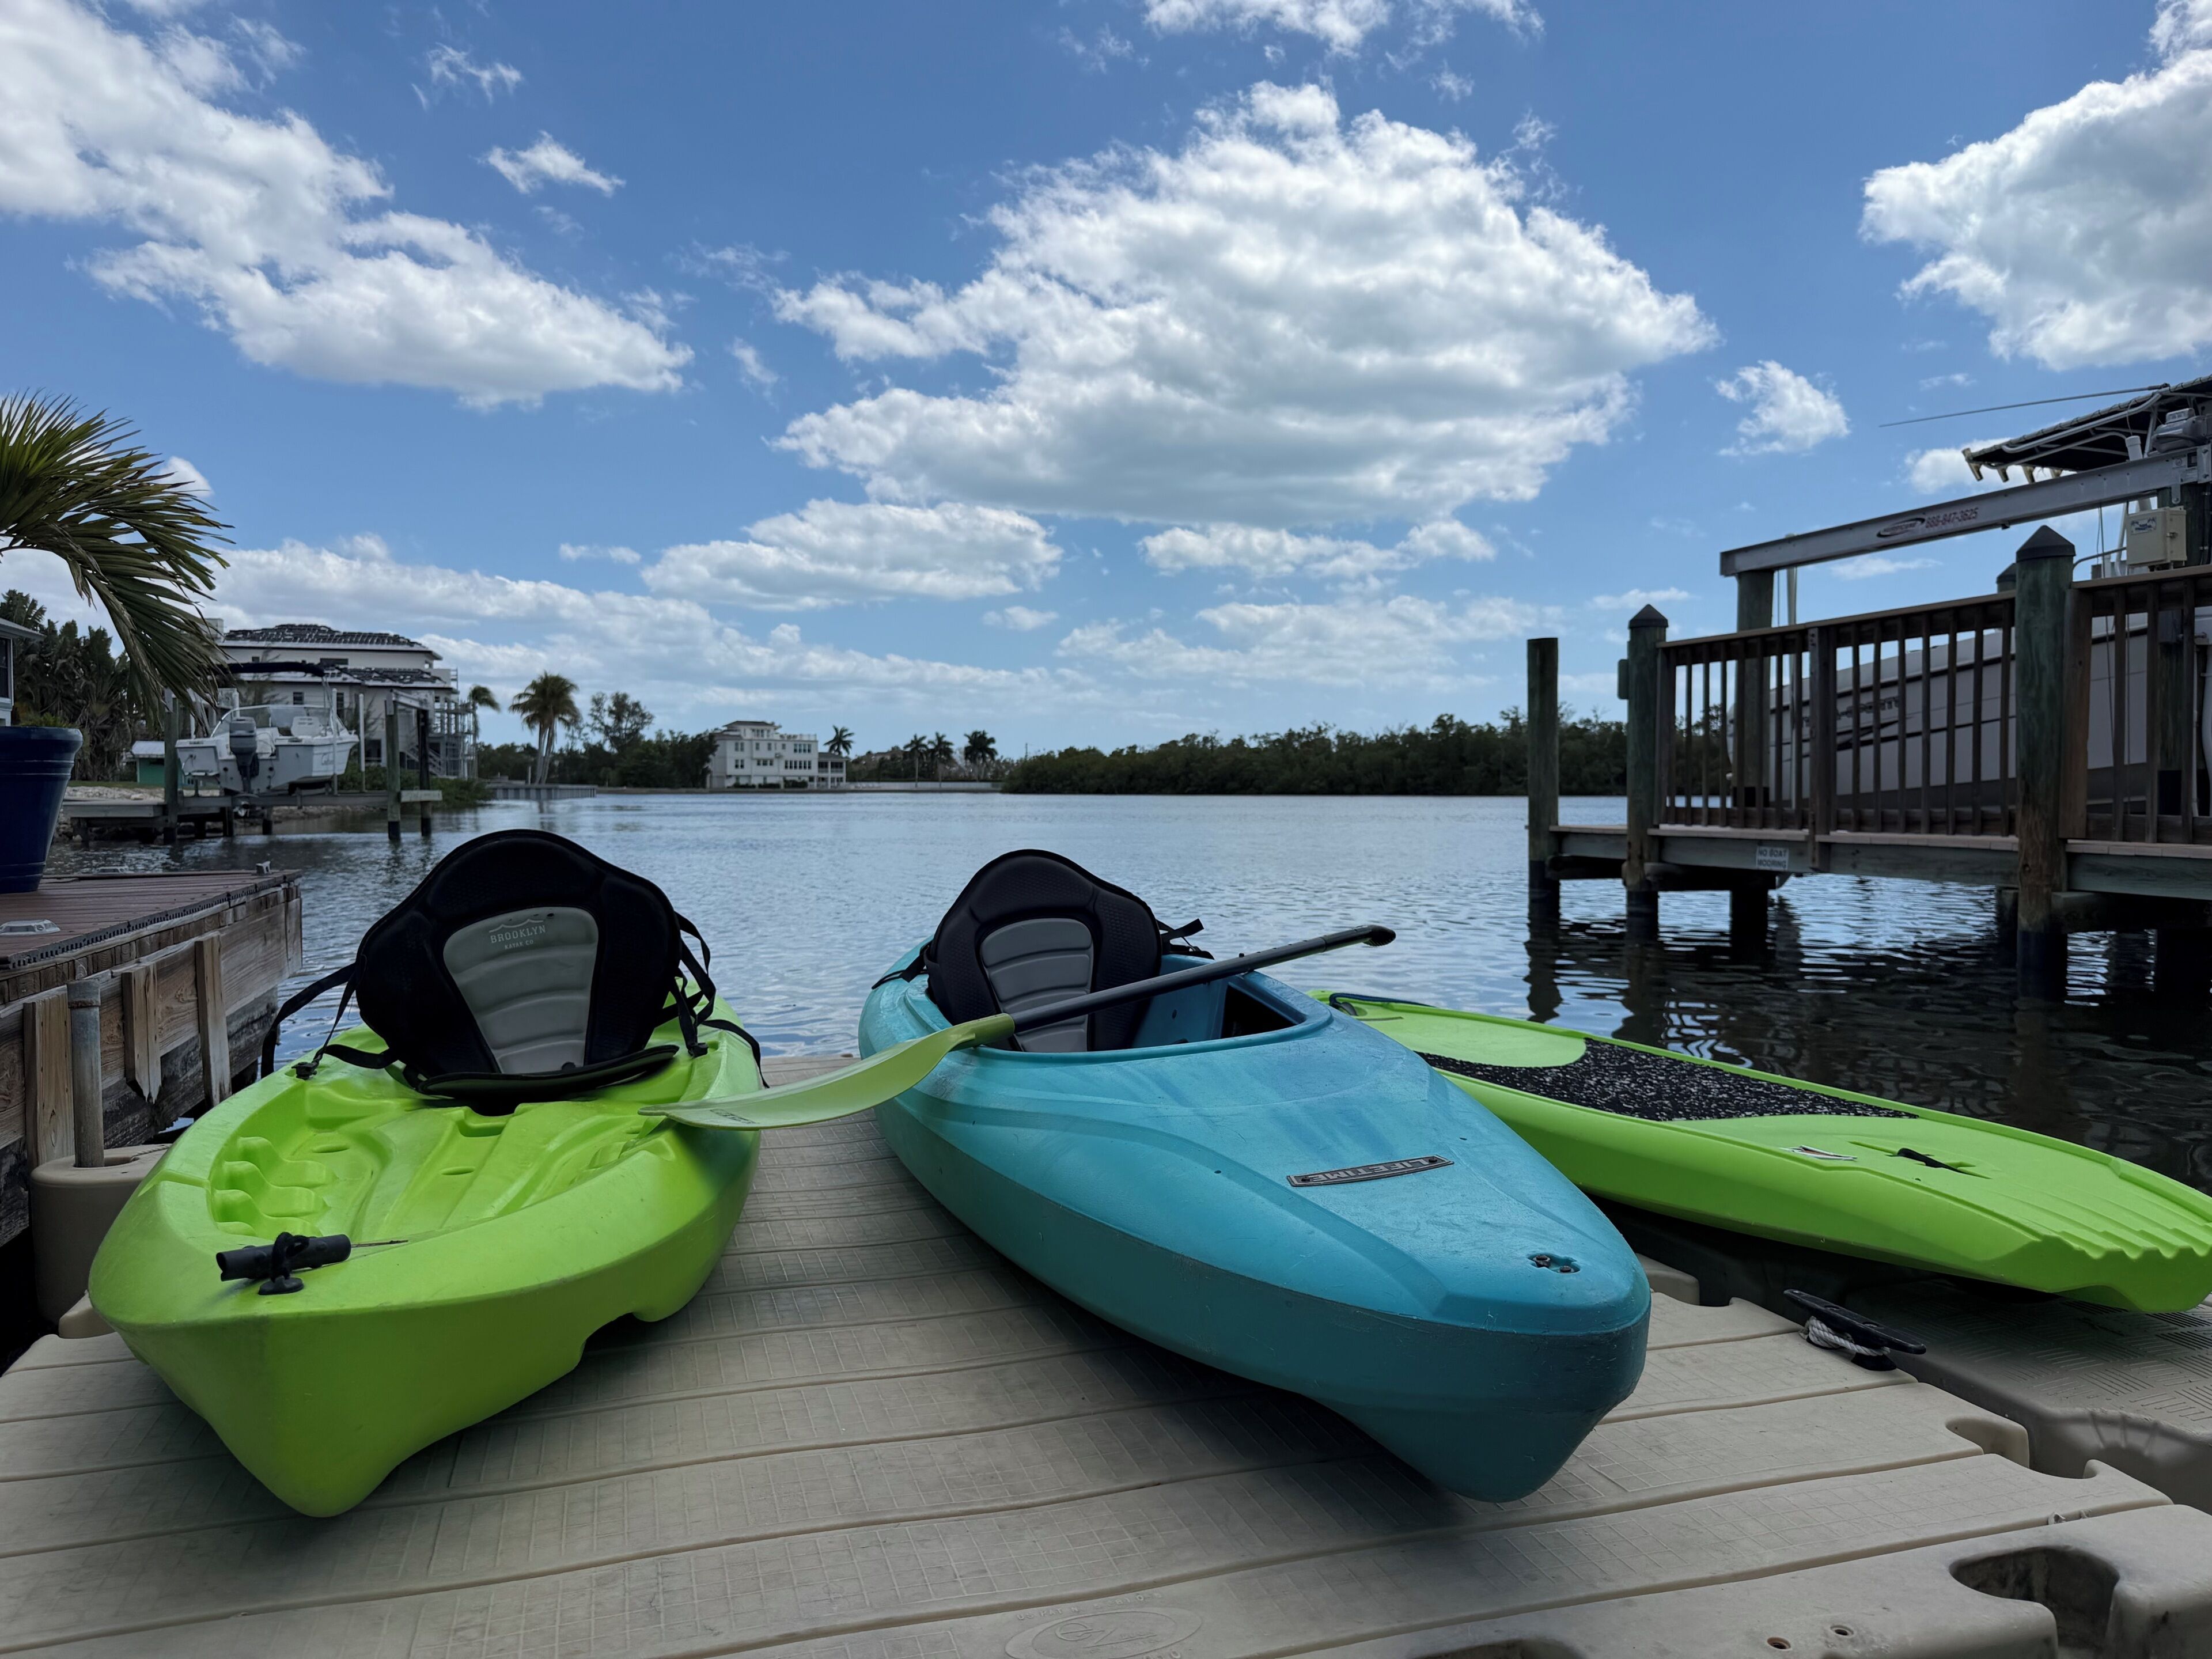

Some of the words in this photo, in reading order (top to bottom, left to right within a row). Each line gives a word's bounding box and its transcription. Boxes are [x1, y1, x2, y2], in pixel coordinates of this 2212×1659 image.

[1759, 849, 1767, 857] NO
[1769, 849, 1786, 857] BOAT
[1758, 859, 1786, 869] MOORING
[491, 925, 546, 944] BROOKLYN
[1309, 1158, 1429, 1181] LIFETIME
